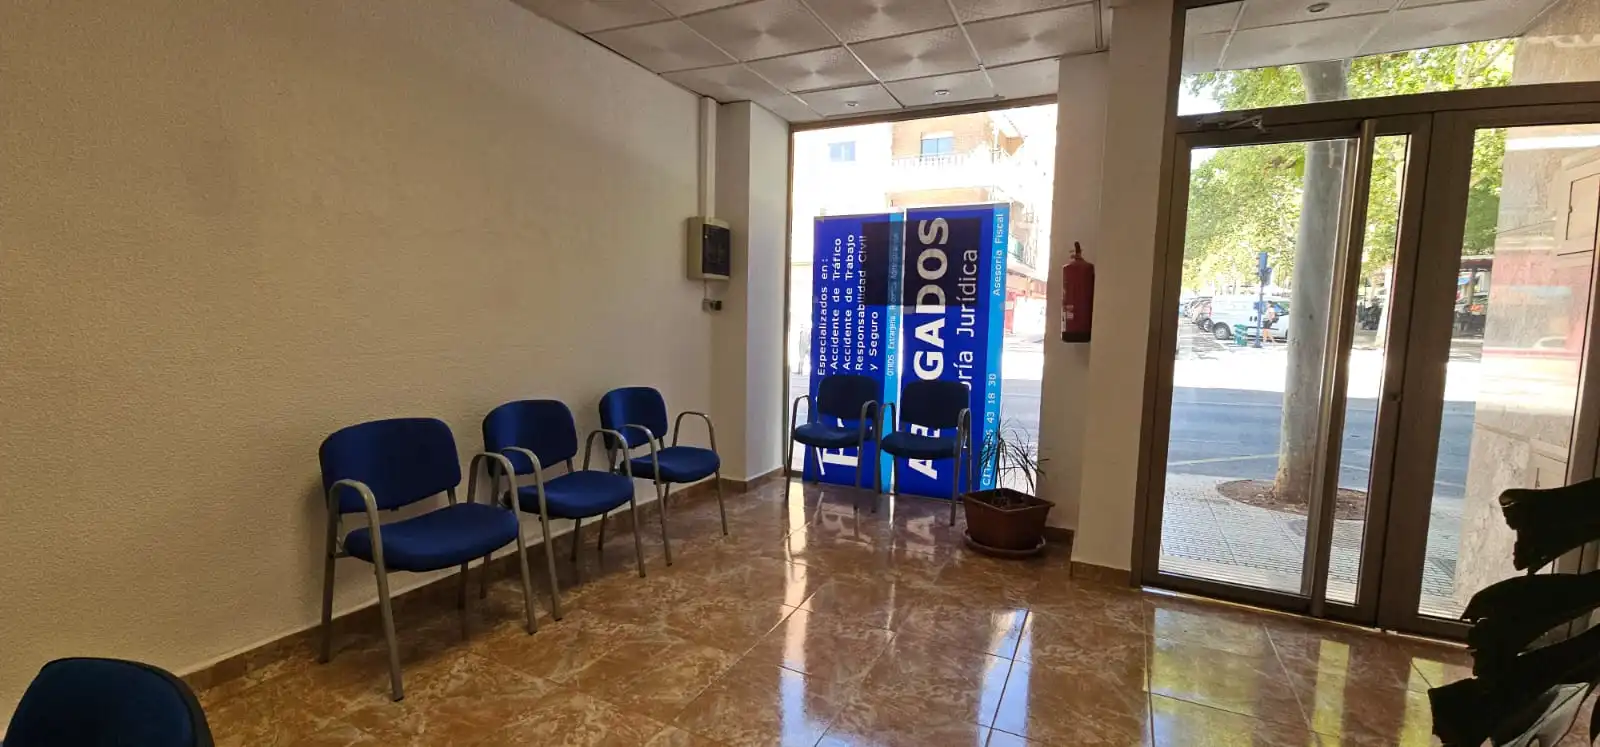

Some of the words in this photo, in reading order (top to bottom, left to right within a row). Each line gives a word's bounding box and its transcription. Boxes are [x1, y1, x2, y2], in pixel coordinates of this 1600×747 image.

[994, 214, 1005, 243] Fiscal
[832, 238, 842, 281] Tráfico
[845, 234, 856, 281] Trabajo
[858, 235, 868, 263] Civil
[832, 287, 840, 303] de
[844, 287, 853, 303] de
[956, 249, 978, 338] Jurídica
[818, 286, 828, 376] Especializados
[869, 311, 880, 357] Seguro
[870, 363, 879, 371] y
[986, 411, 996, 424] 43
